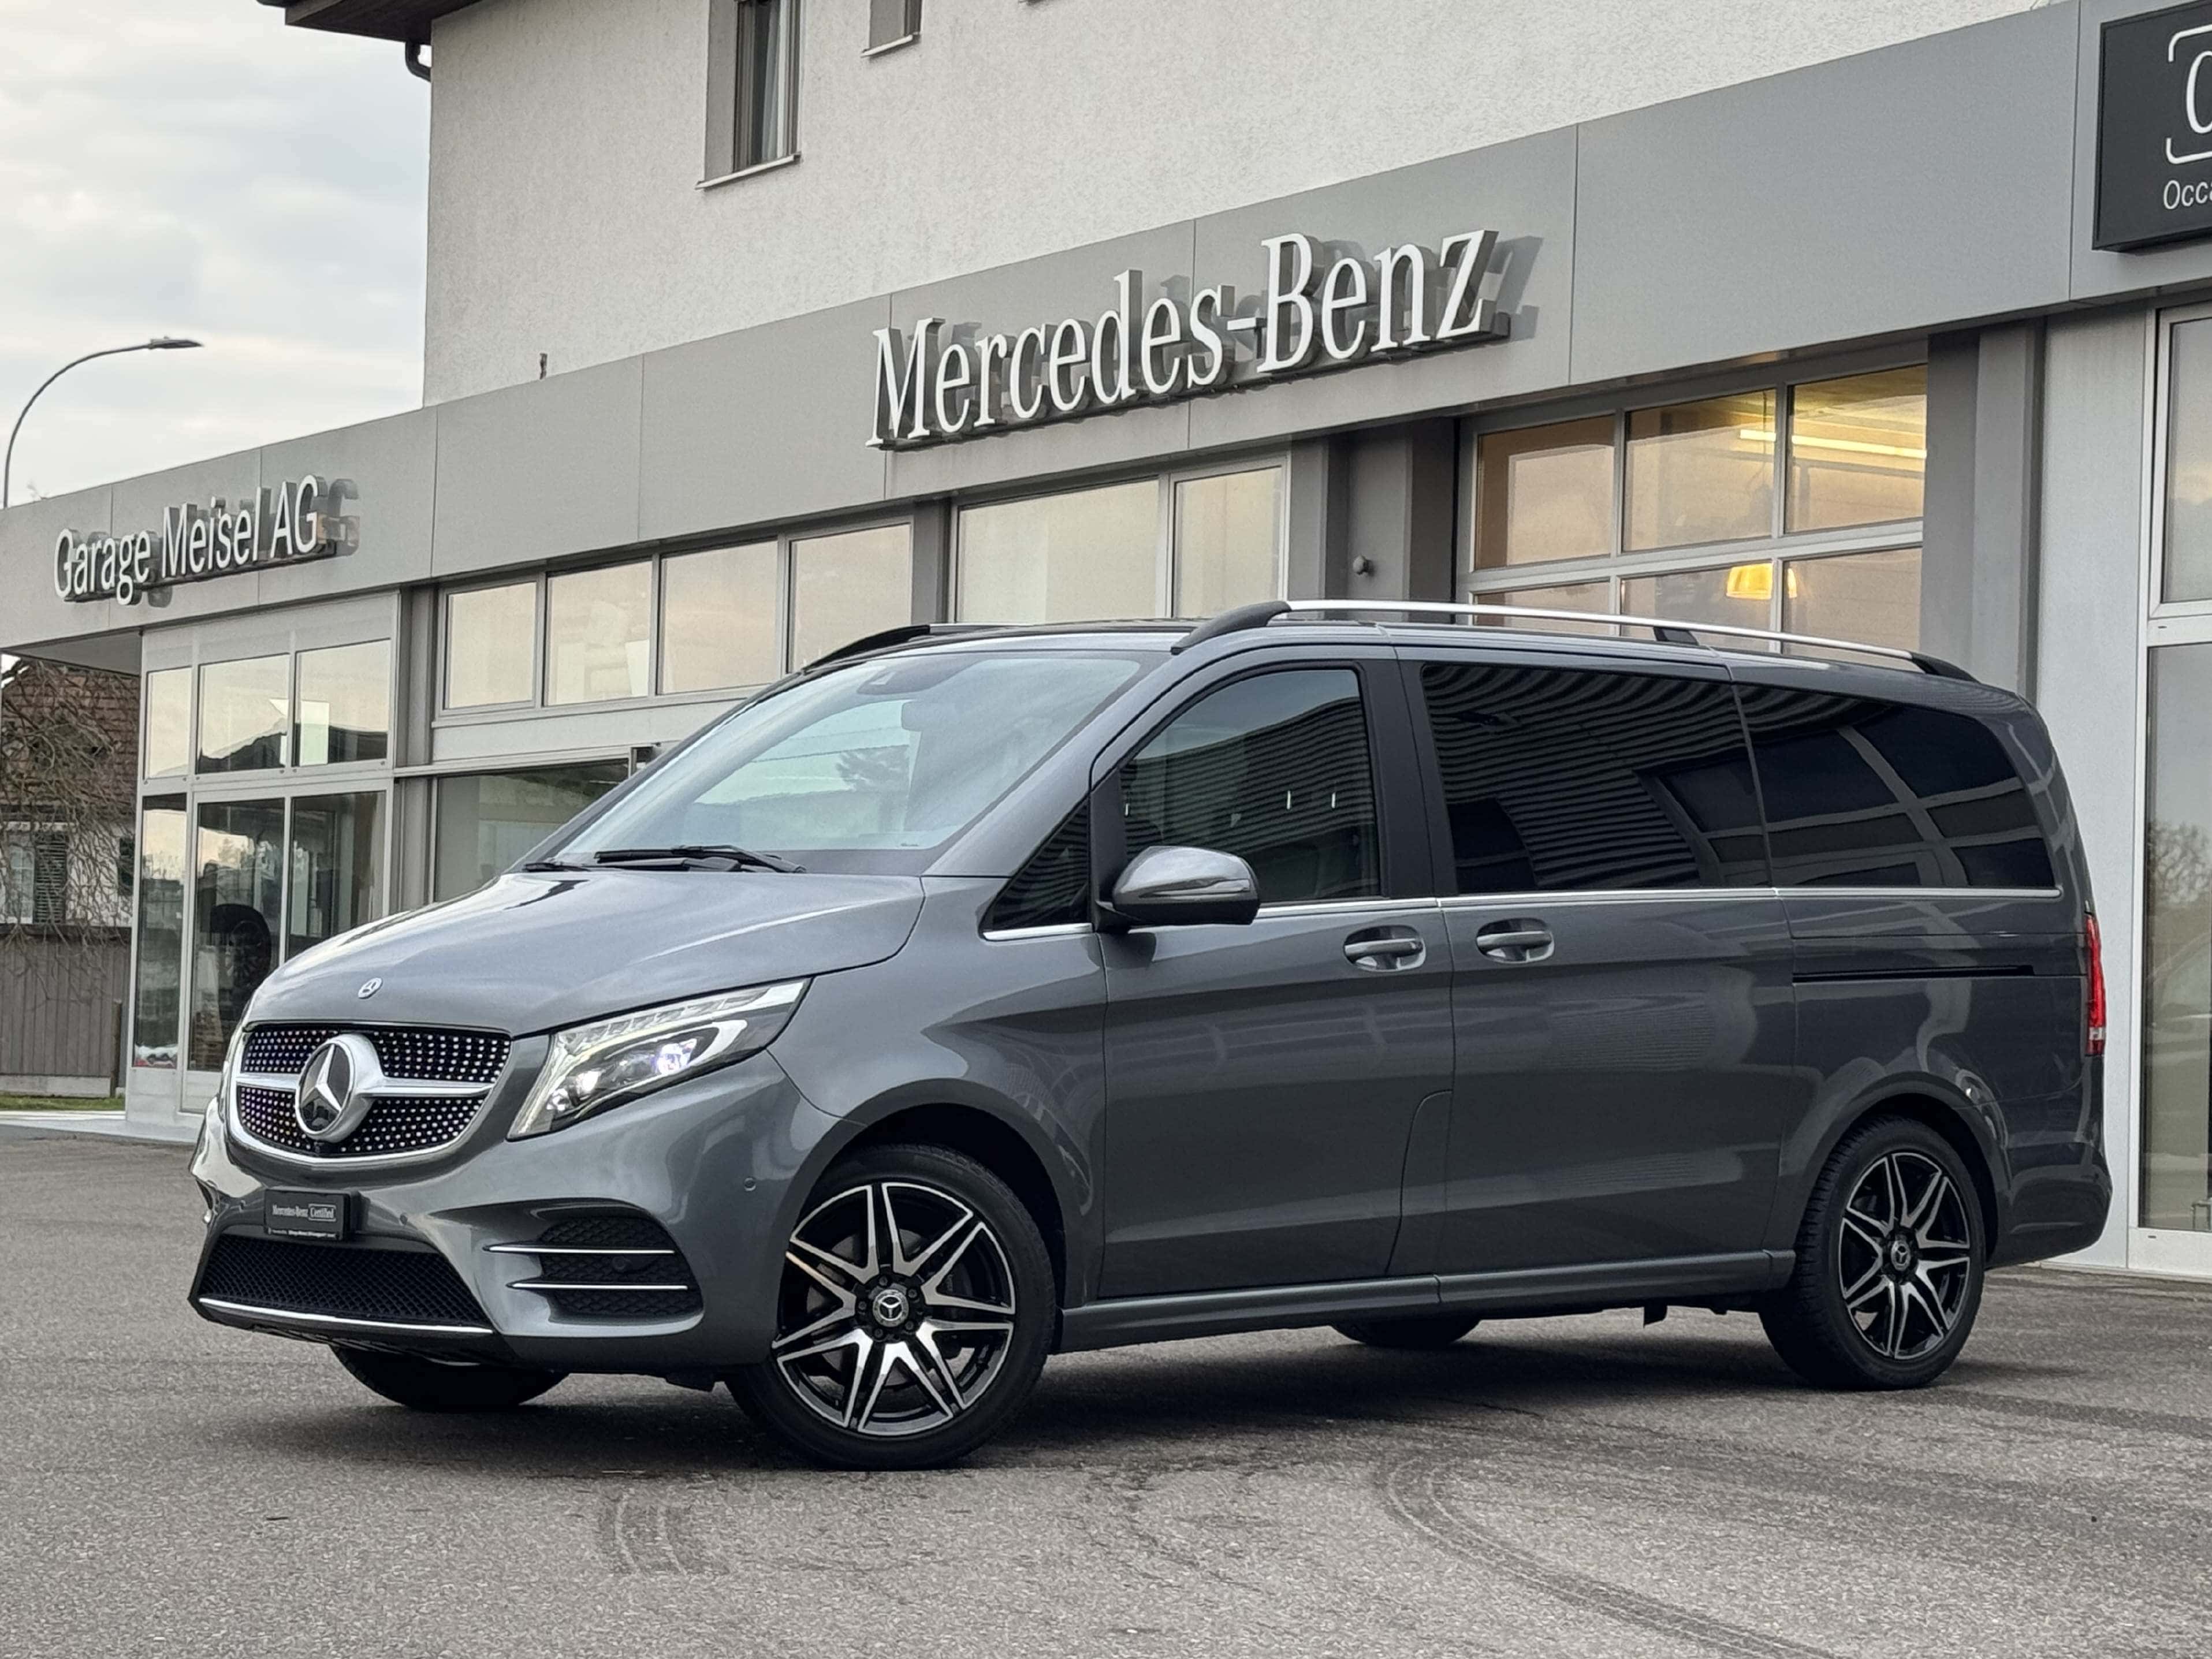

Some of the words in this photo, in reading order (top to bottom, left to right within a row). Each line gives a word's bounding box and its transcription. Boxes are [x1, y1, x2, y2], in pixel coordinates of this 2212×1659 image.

[2163, 179, 2212, 210] Occ
[866, 229, 1499, 448] Mercedes-Benz
[54, 528, 151, 606] Garage
[162, 486, 260, 577] Meisel
[269, 474, 318, 558] AG
